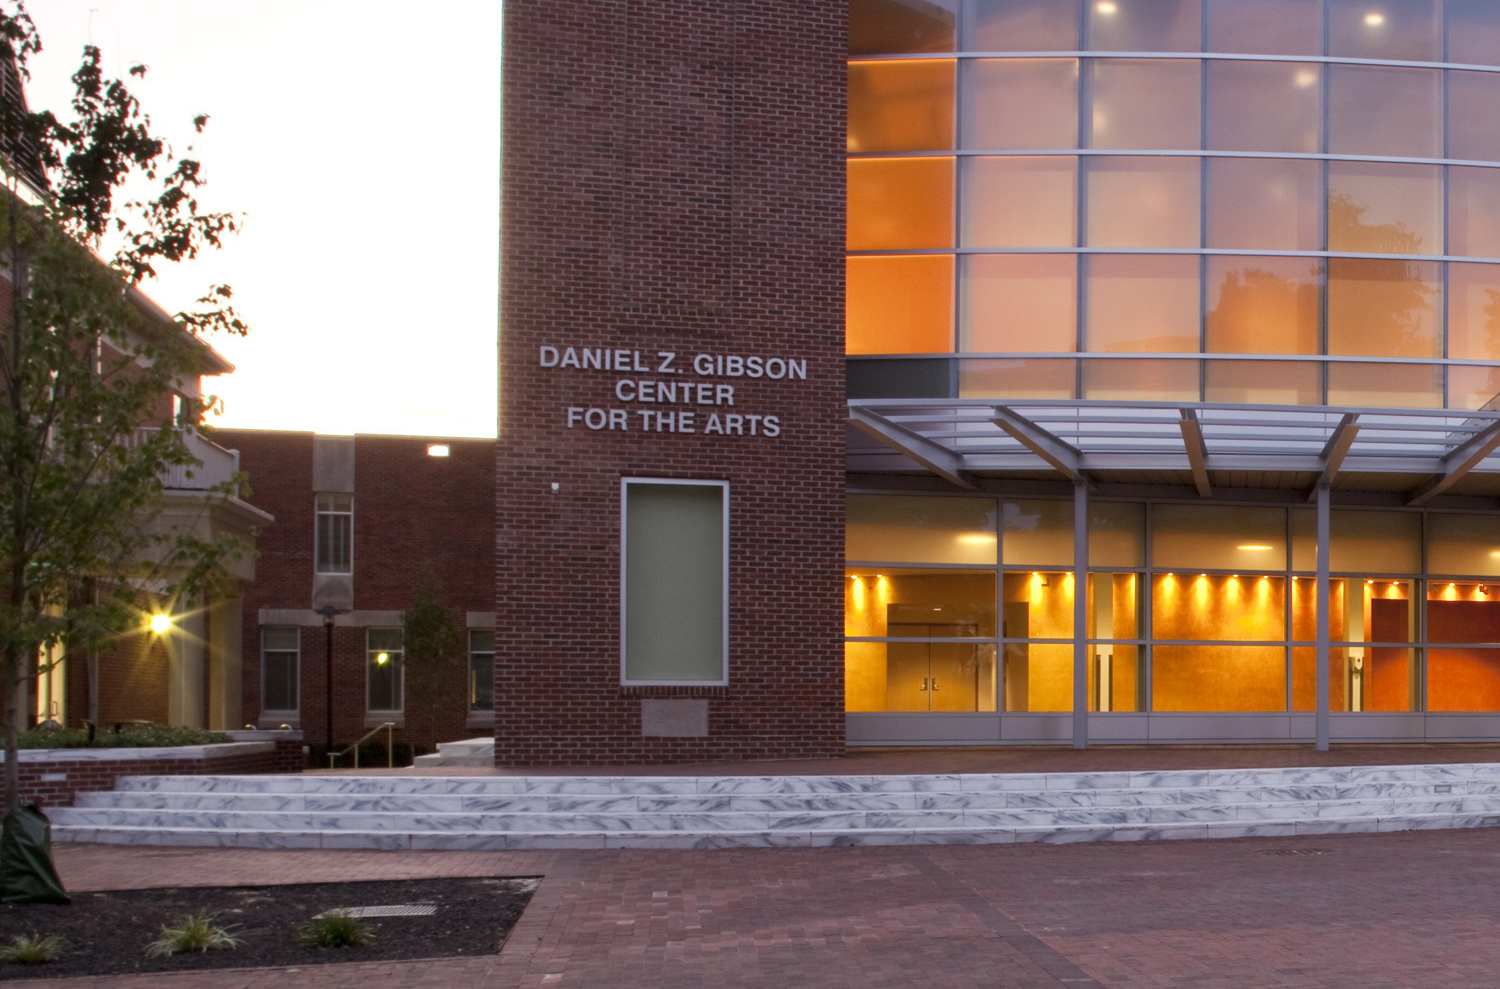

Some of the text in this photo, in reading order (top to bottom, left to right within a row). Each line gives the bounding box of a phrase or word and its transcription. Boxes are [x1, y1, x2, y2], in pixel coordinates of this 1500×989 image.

[539, 345, 806, 379] DANIEL Z. GIBSON
[615, 379, 734, 405] CENTER
[567, 406, 780, 437] FOR THE ARTS
